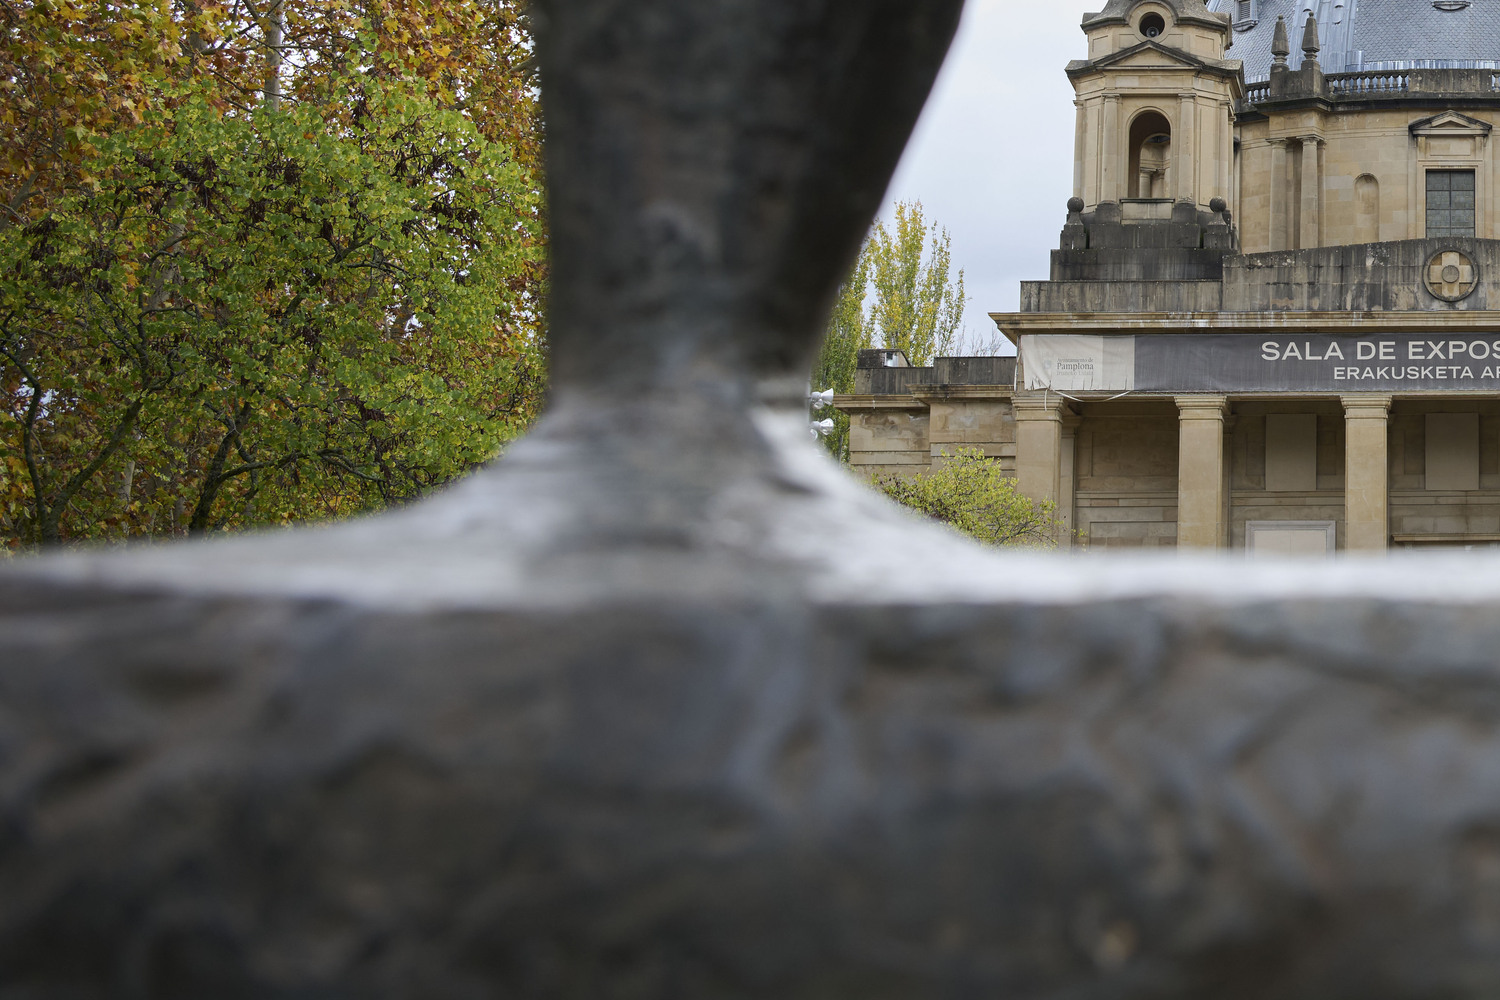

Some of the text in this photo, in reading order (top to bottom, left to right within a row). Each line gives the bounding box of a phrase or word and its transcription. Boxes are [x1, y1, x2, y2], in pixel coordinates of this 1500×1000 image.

[1261, 341, 1345, 361] SALA
[1356, 341, 1396, 360] DE
[1057, 362, 1094, 371] Pamplona
[1334, 366, 1474, 380] ERAKUSKETA
